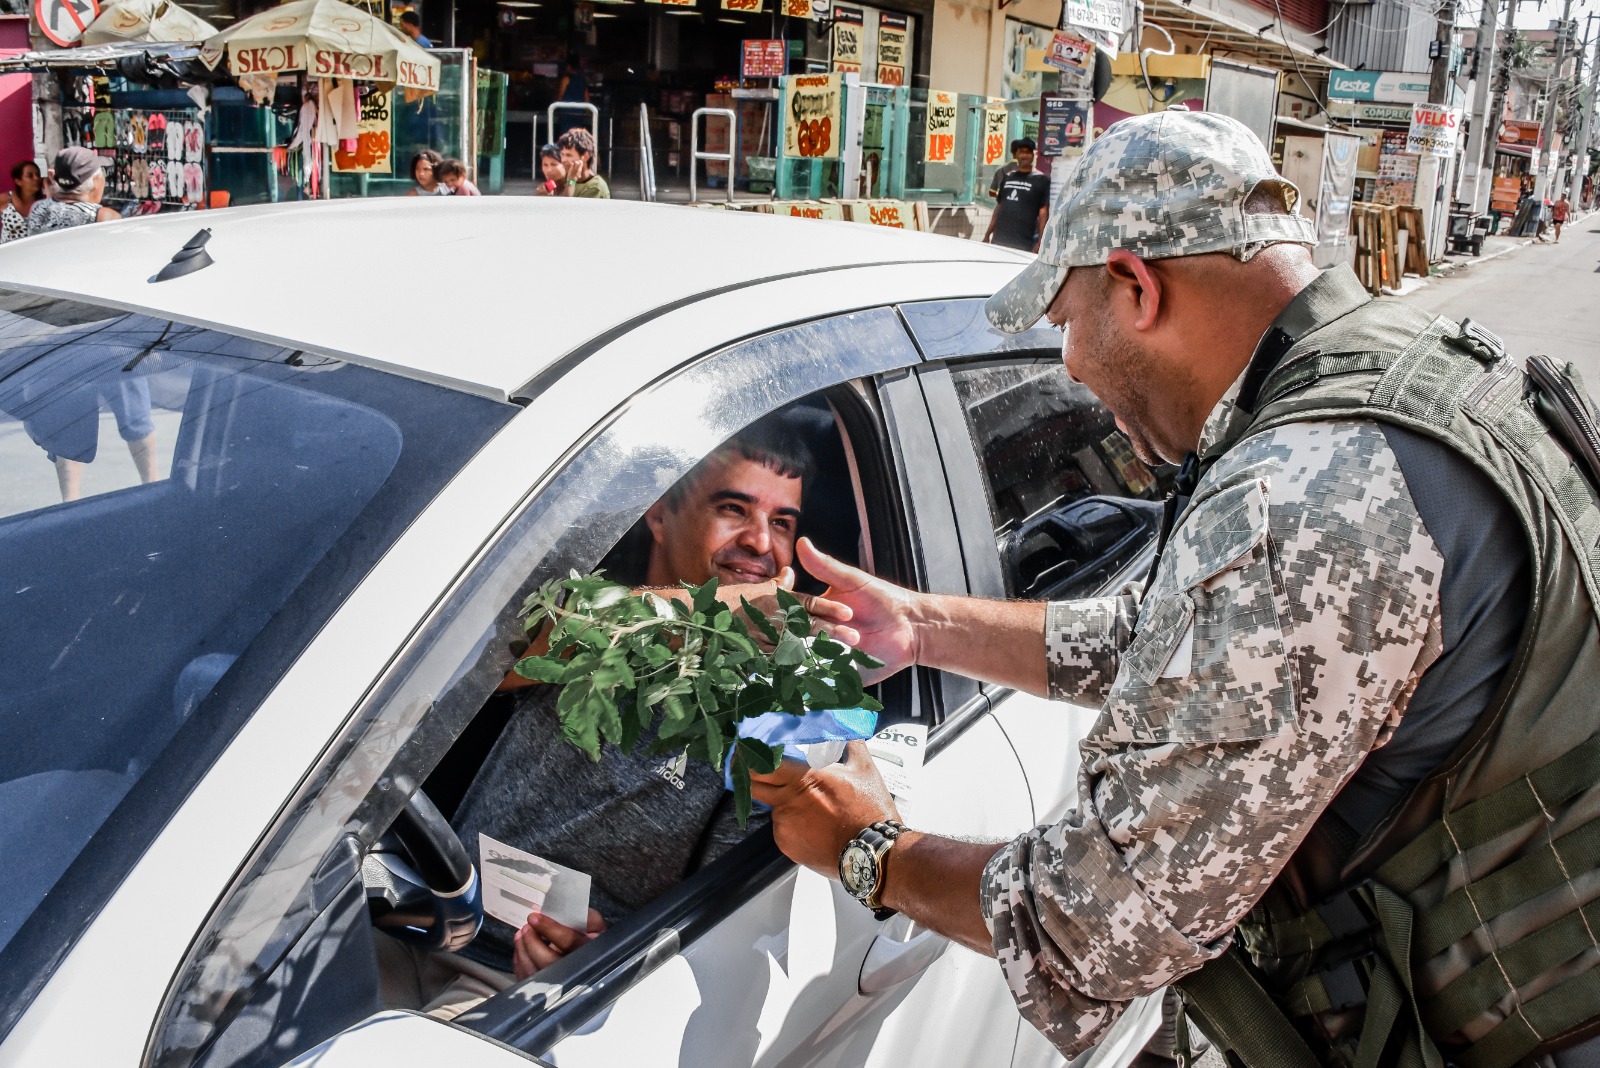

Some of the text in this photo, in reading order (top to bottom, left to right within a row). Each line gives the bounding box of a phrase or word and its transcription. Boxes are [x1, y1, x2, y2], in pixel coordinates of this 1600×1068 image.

[237, 45, 300, 74] SKOL
[315, 50, 389, 78] SKOL
[399, 60, 436, 88] SKOL
[1333, 77, 1371, 93] Leste
[1363, 107, 1404, 120] COMPRE
[1415, 109, 1456, 129] VELAS
